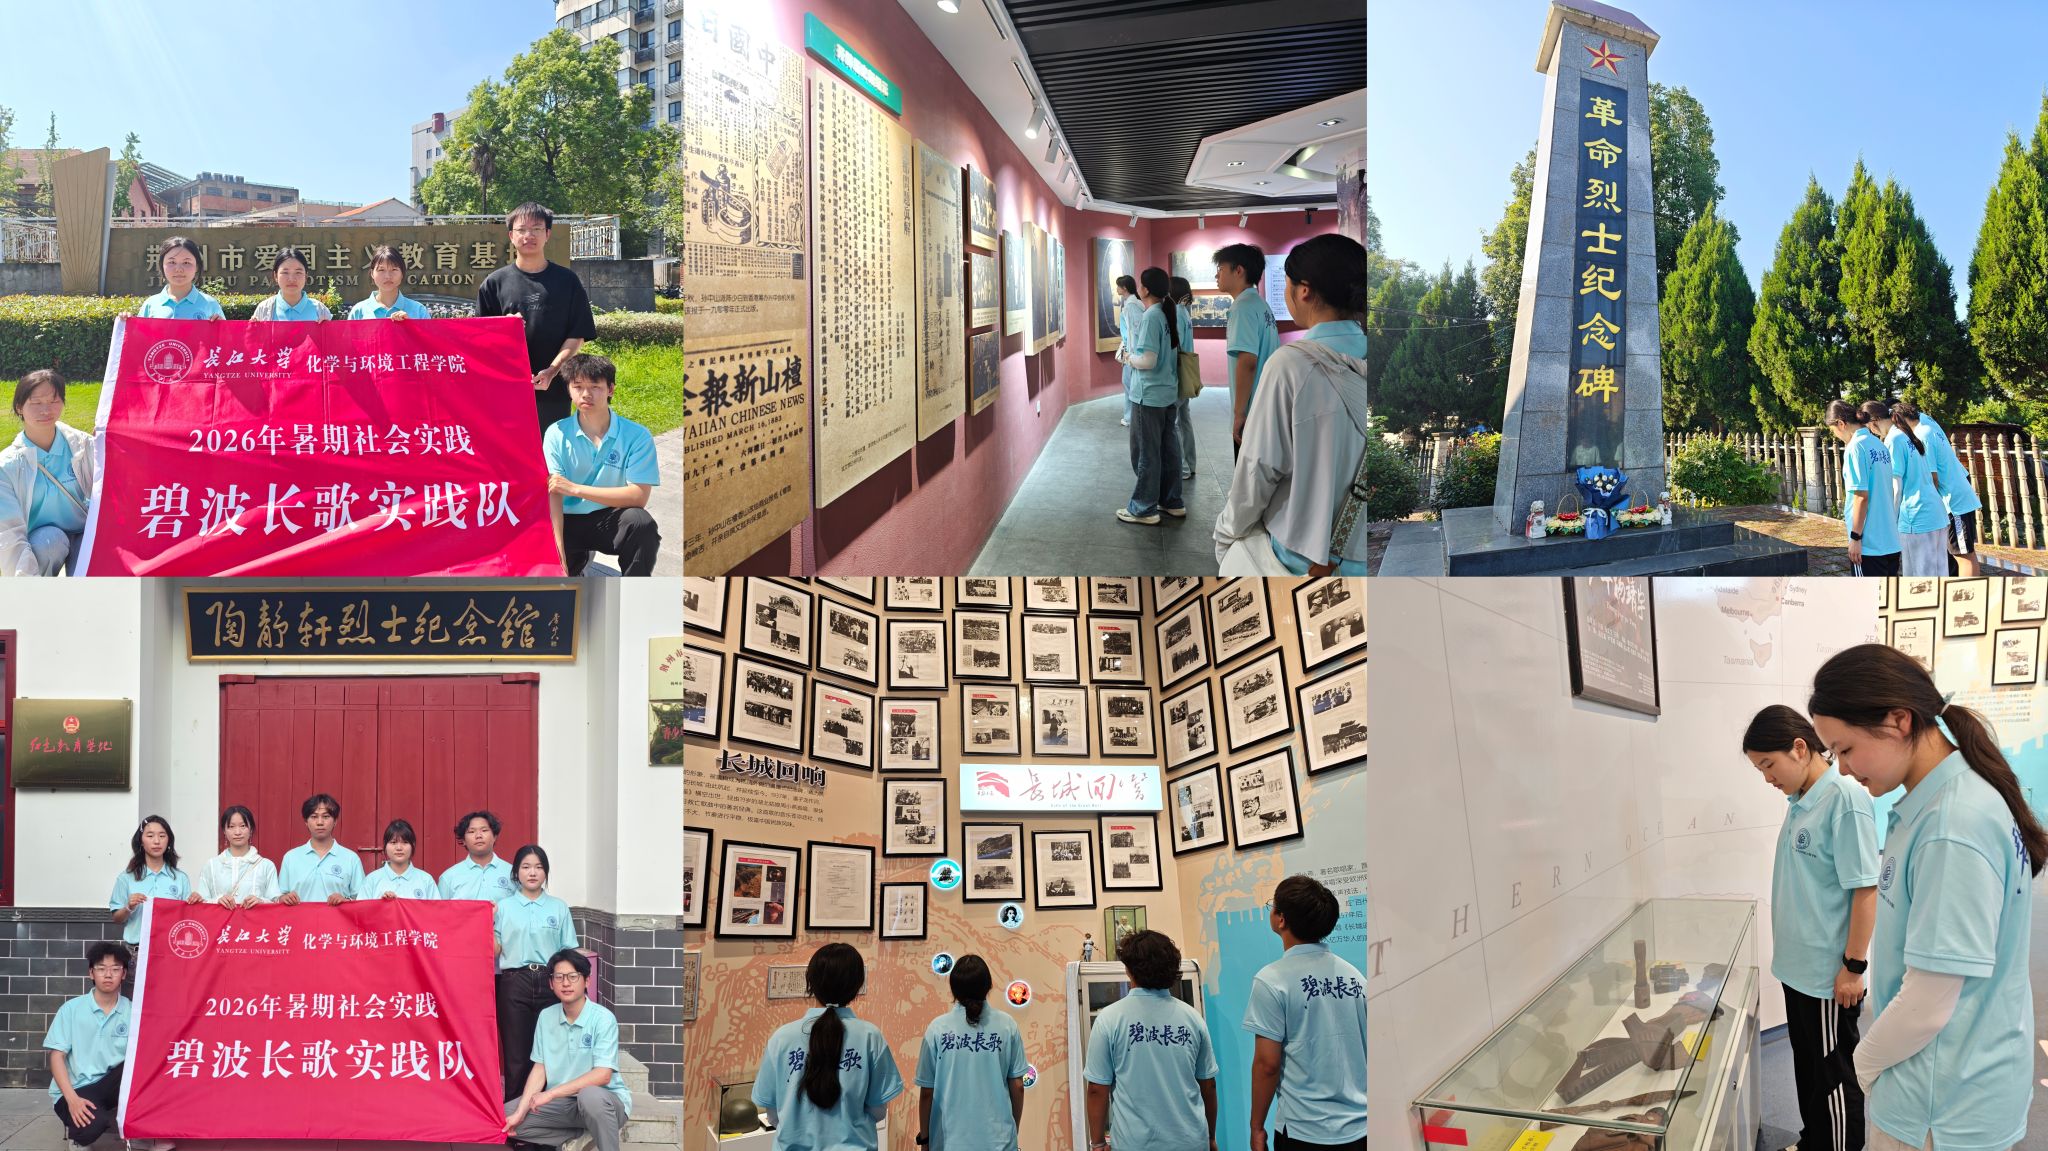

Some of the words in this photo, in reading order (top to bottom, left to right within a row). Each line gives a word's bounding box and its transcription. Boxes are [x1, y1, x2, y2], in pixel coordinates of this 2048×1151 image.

[1574, 96, 1623, 403] 革命烈士纪念碑
[307, 353, 467, 374] 化学与环境工程学院
[244, 371, 292, 379] UNIVERSITY
[684, 416, 727, 440] AIIAN
[730, 401, 777, 426] CHINESE
[780, 393, 805, 411] NEWS
[188, 424, 475, 456] 2026年暑期社会实践
[727, 424, 755, 440] MARCH
[137, 480, 520, 539] 碧波长歌实践队
[1788, 584, 1807, 595] Sydney
[1721, 606, 1750, 617] Melbourne
[1781, 597, 1805, 608] Canberra
[1723, 655, 1754, 667] Tasmania
[718, 748, 827, 788] 长城回响
[302, 930, 439, 951] 化学与环境工程学院
[216, 947, 248, 955] YANGTZE
[250, 948, 291, 956] UNIVERSITY
[204, 992, 439, 1019] 2026年暑期社会实践
[165, 1038, 475, 1081] 碧波长歌实践队
[788, 1048, 862, 1076] 碧歌
